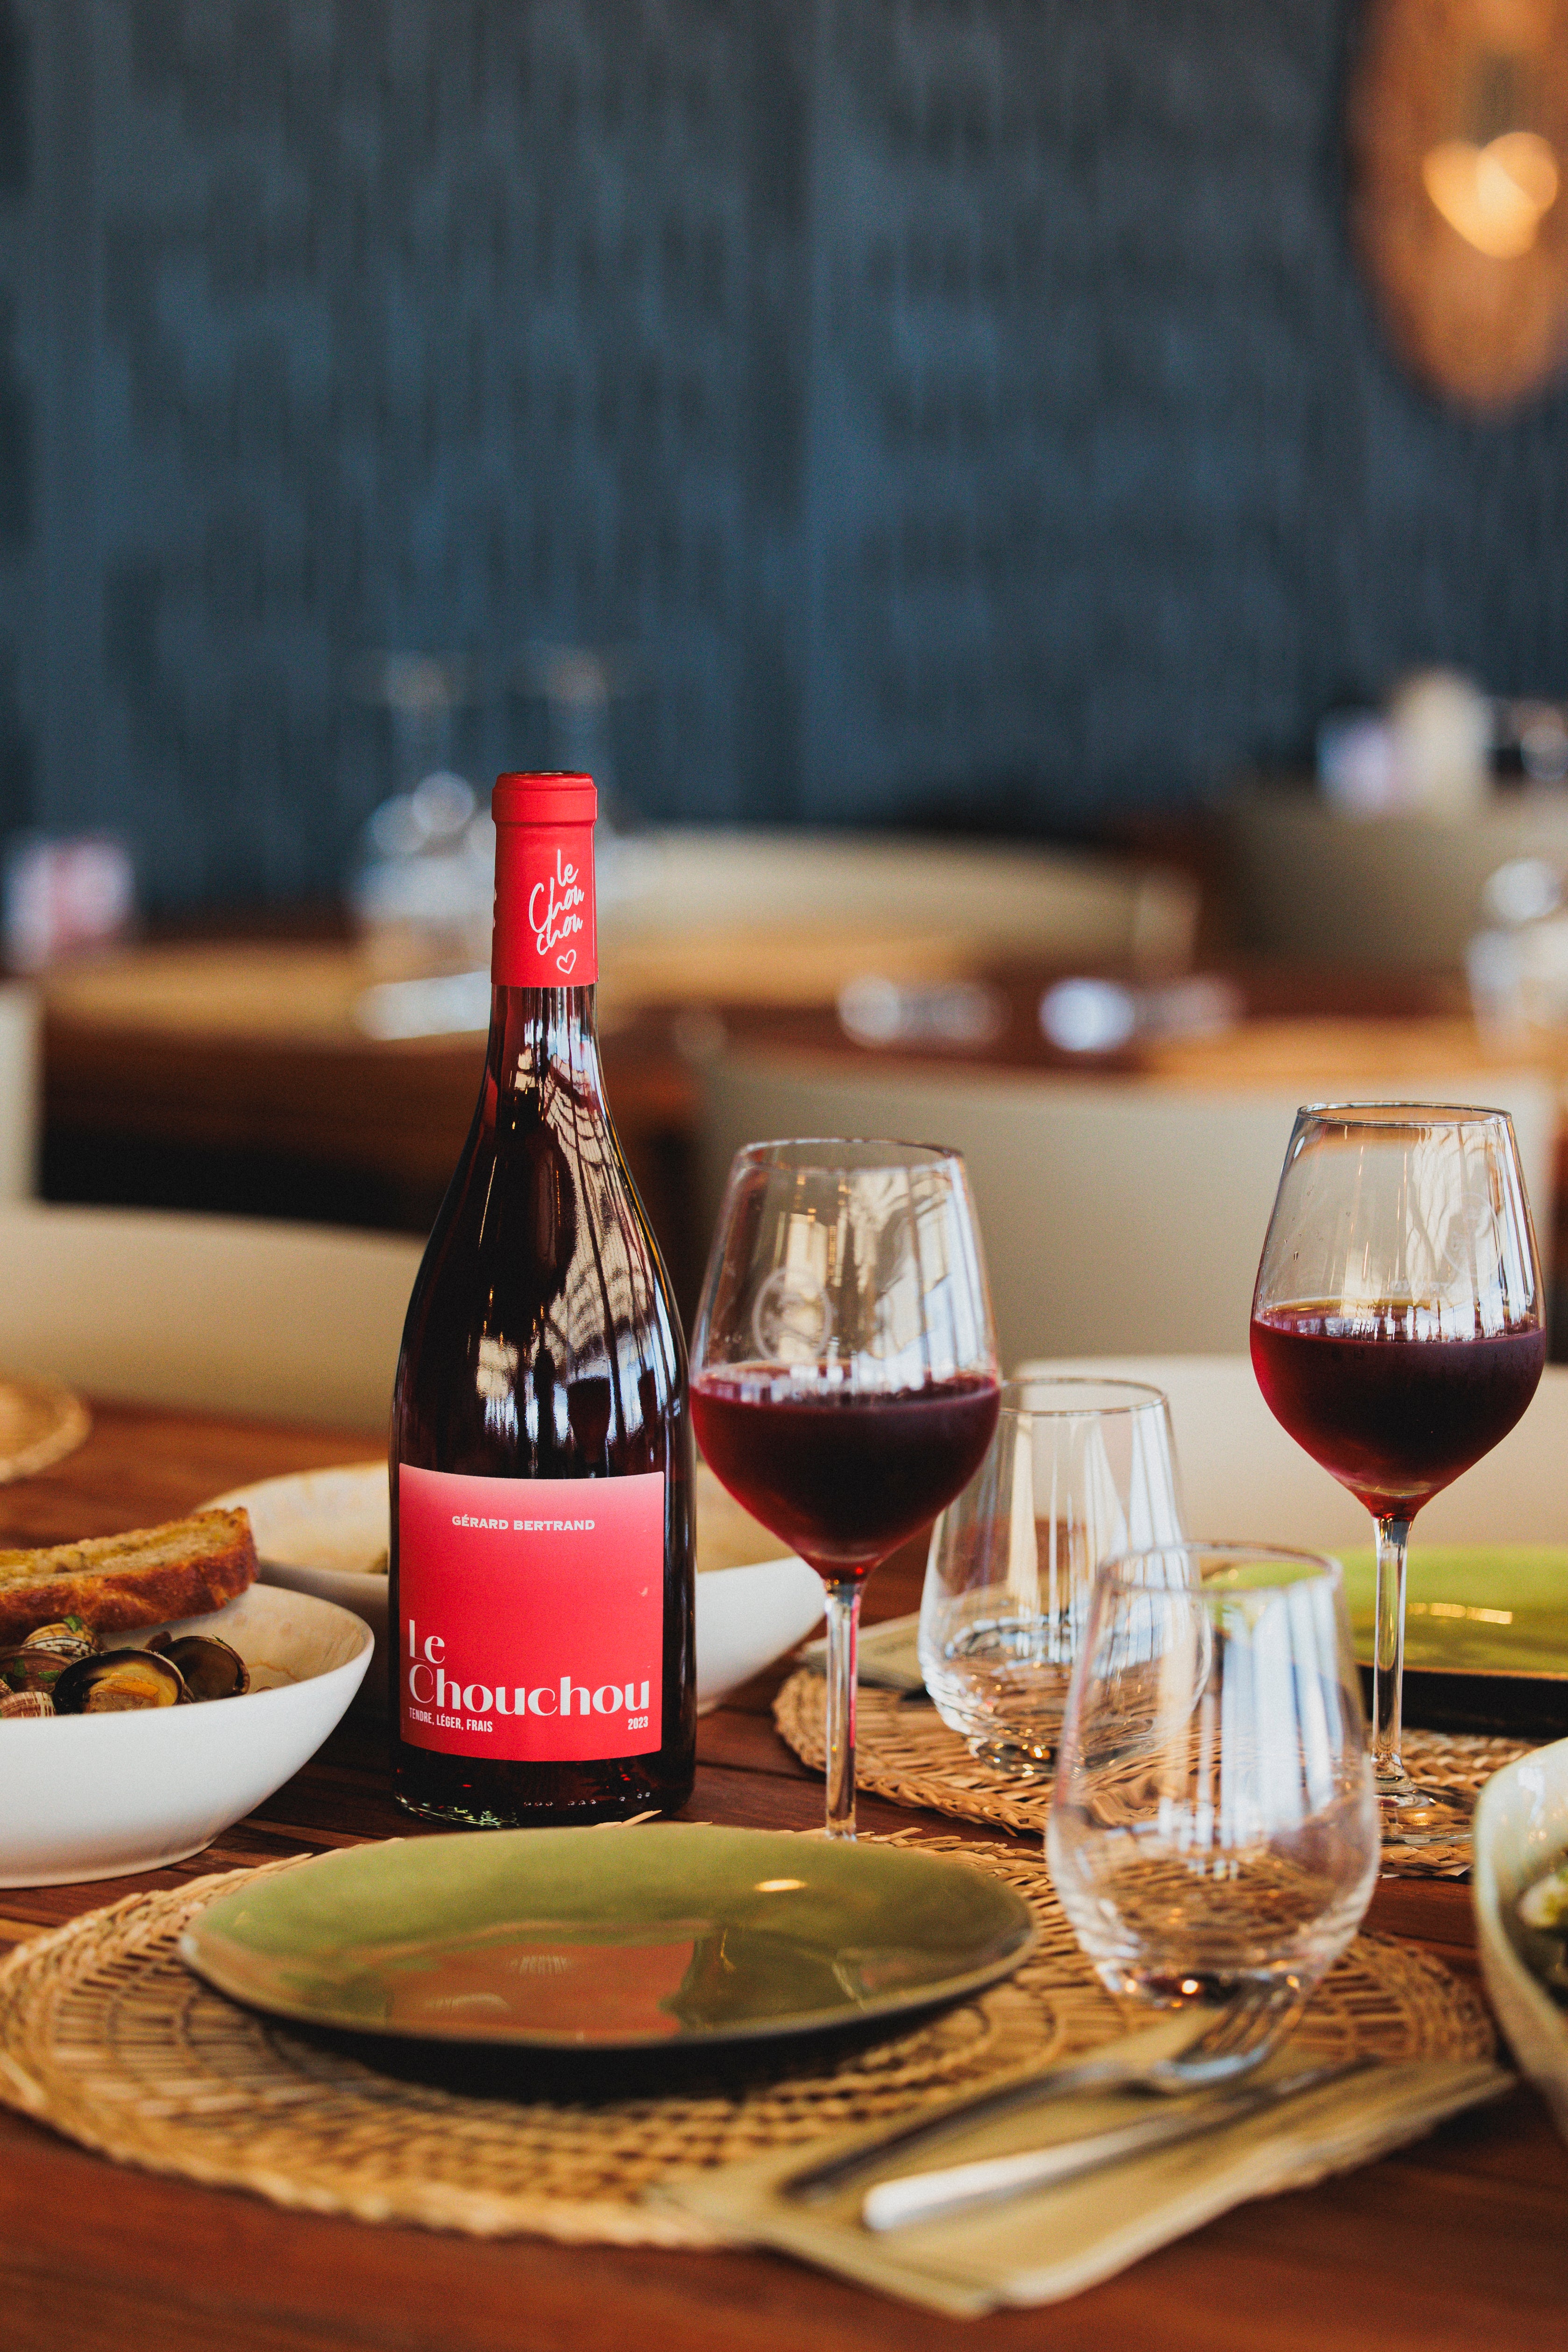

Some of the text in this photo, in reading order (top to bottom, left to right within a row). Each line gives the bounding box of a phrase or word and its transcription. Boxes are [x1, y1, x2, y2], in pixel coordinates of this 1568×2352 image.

[529, 877, 584, 933] Chou
[452, 1514, 595, 1531] GÉRARD BERTRAND
[409, 1619, 445, 1664] Le
[409, 1664, 650, 1716] Chouchou
[409, 1707, 493, 1733] TENDRE, LÉGER, FRAIS
[628, 1716, 649, 1730] 2023
